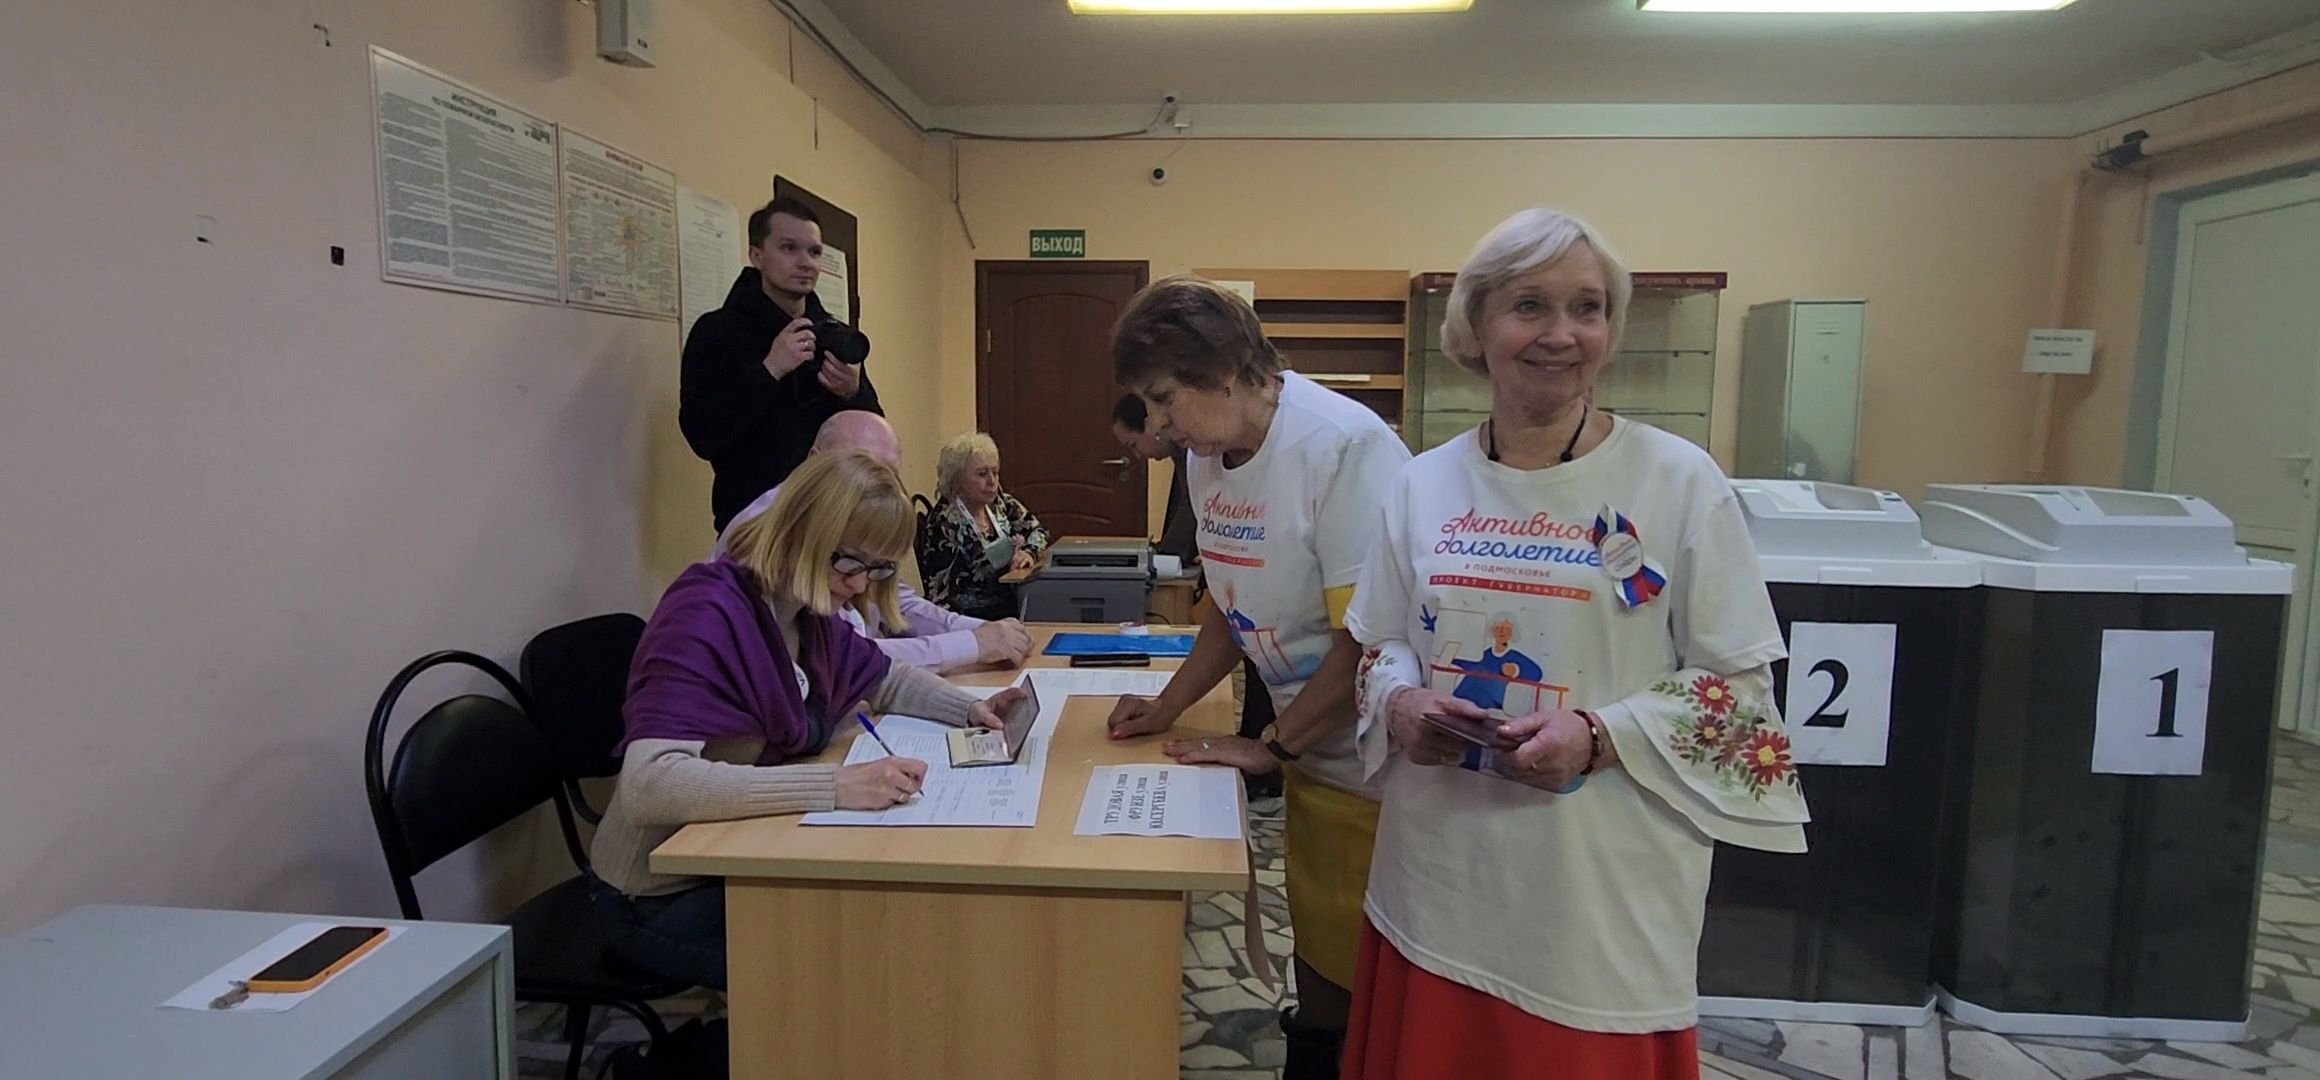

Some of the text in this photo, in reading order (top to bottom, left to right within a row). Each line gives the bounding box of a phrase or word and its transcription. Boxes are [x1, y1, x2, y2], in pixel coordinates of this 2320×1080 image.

[1032, 236, 1083, 254] ВЫХОД
[1434, 532, 1603, 568] долголетие
[1432, 576, 1479, 585] ПРОЕКТ
[1802, 658, 1850, 728] 2
[2145, 667, 2184, 738] 1
